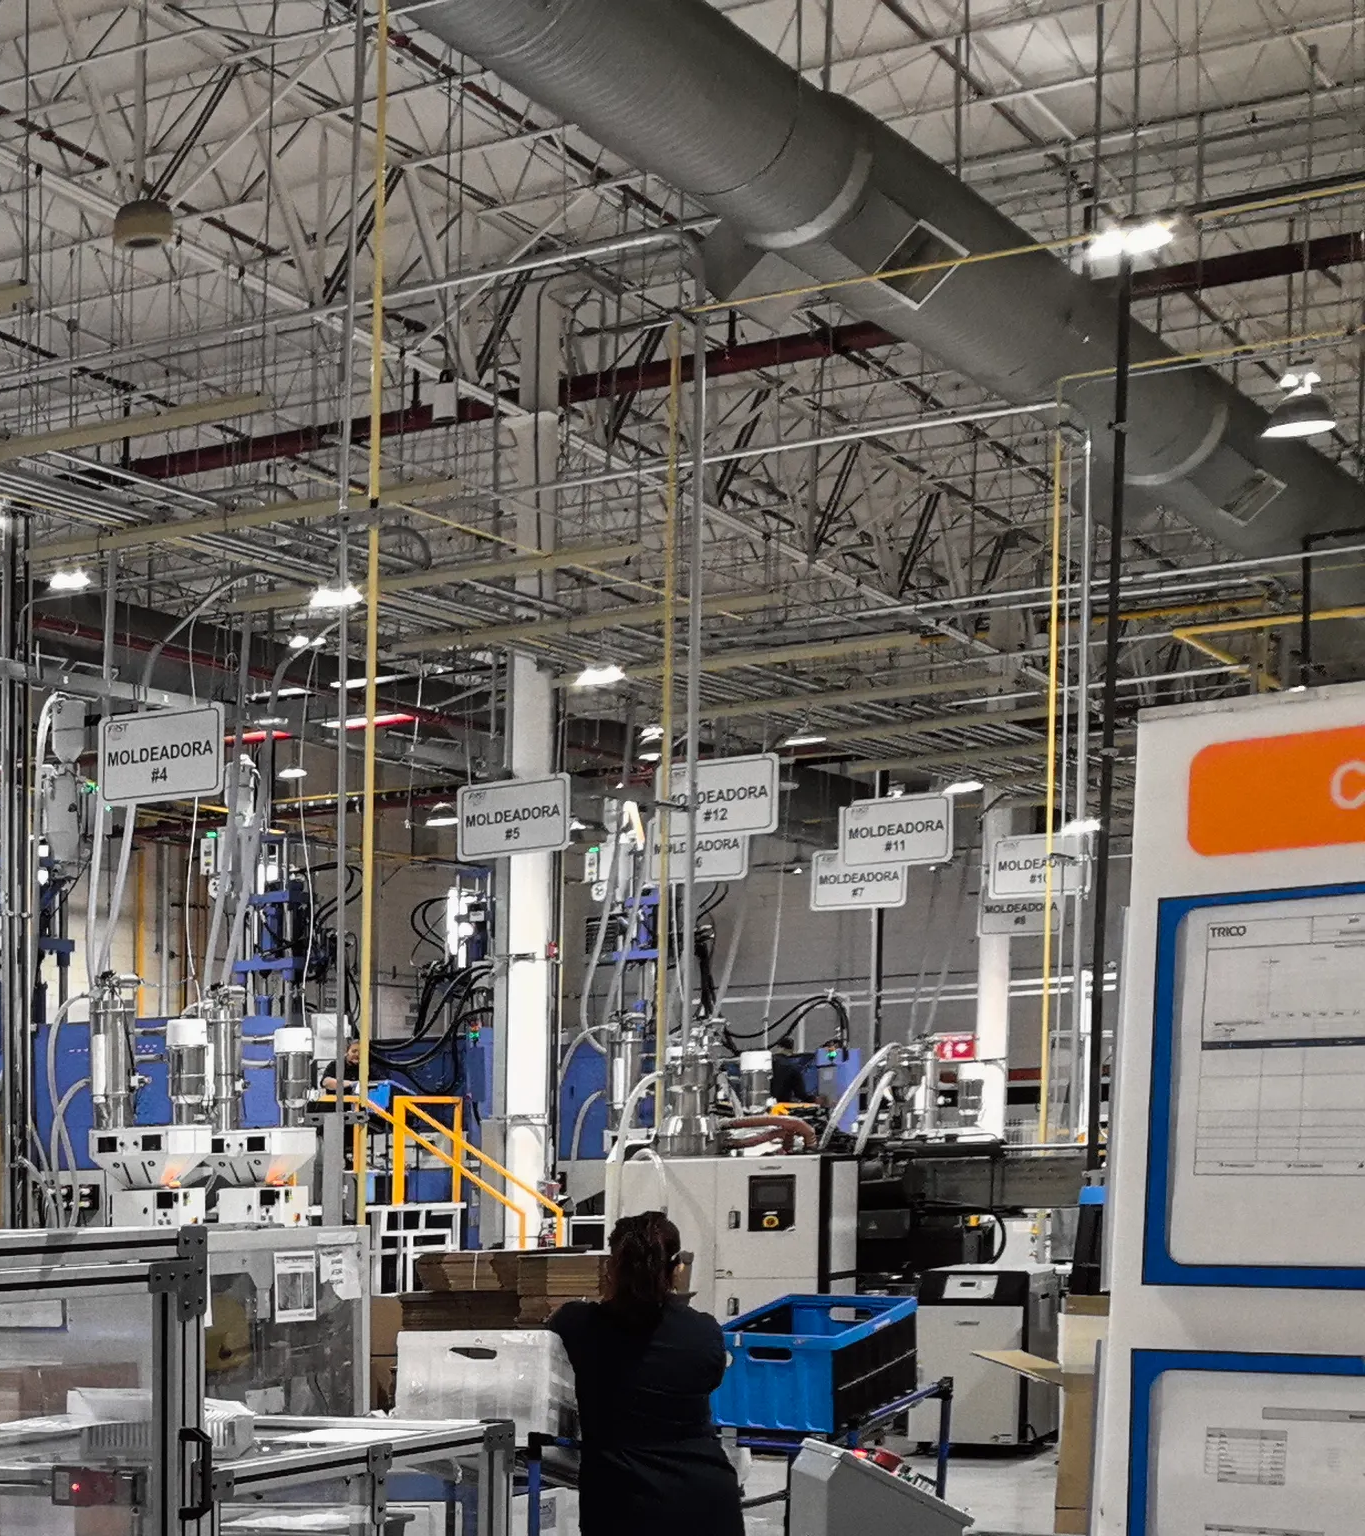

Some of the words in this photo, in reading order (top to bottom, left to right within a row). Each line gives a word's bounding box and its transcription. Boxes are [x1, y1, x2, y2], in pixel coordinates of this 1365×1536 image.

[108, 740, 213, 767] MOLDEADORA
[151, 767, 168, 783] #4
[466, 804, 561, 828] MOLDEADORA
[703, 808, 728, 822] #12
[505, 827, 520, 840] #5
[848, 820, 944, 839] MOLDEADORA
[884, 840, 906, 852] #11
[819, 871, 899, 885] MOLDEADORA
[985, 902, 1058, 914] MOLDEADOA
[1210, 925, 1247, 937] TRICO
